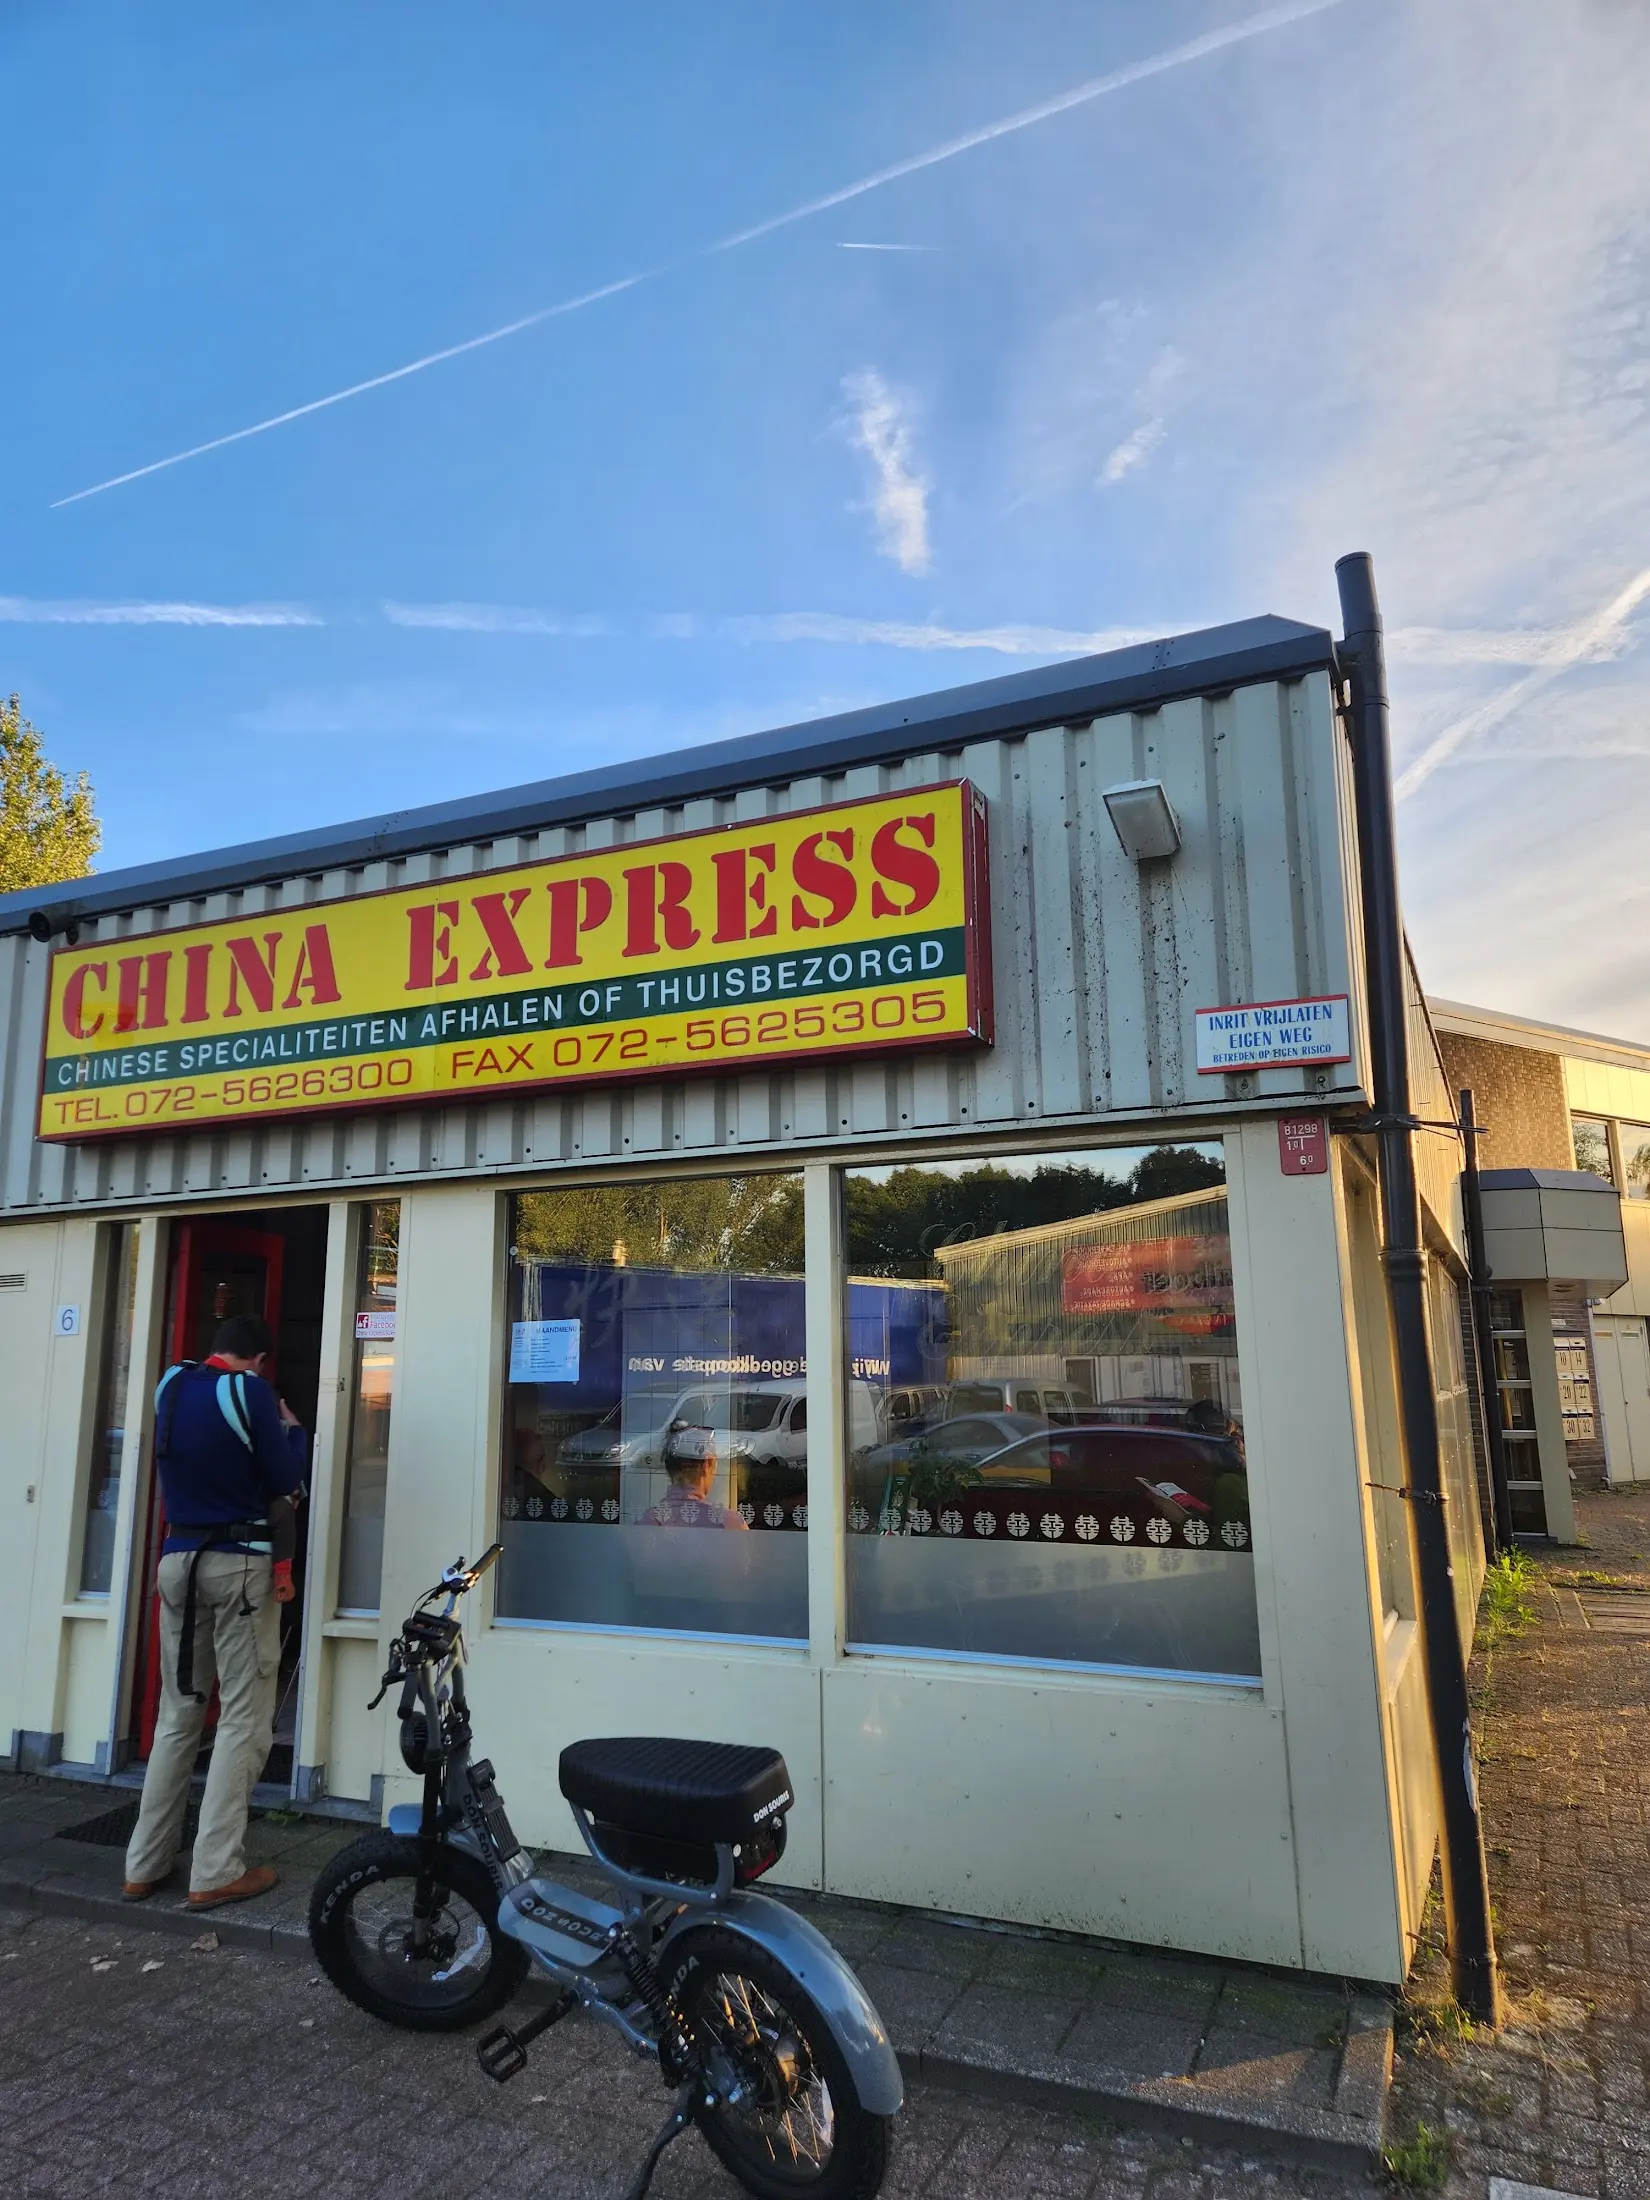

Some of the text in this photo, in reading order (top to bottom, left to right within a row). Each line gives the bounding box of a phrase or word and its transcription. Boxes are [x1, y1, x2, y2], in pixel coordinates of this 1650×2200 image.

[62, 812, 941, 1040] CHINA EXPRESS
[58, 940, 945, 1085] CHINESE SPECIALITEITEN AFHALEN OF THUISBEZORGD
[1209, 1003, 1333, 1031] INRIT VRIJLATEN
[452, 1043, 534, 1079] FAX
[553, 989, 946, 1068] 072-5625305
[1229, 1026, 1312, 1049] EIGEN WEG
[1213, 1044, 1331, 1063] BETREDEN OP EIGEN RISICO
[1284, 1123, 1318, 1136] B1298
[61, 1308, 74, 1331] 6
[753, 1789, 790, 1823] DON SOURIS
